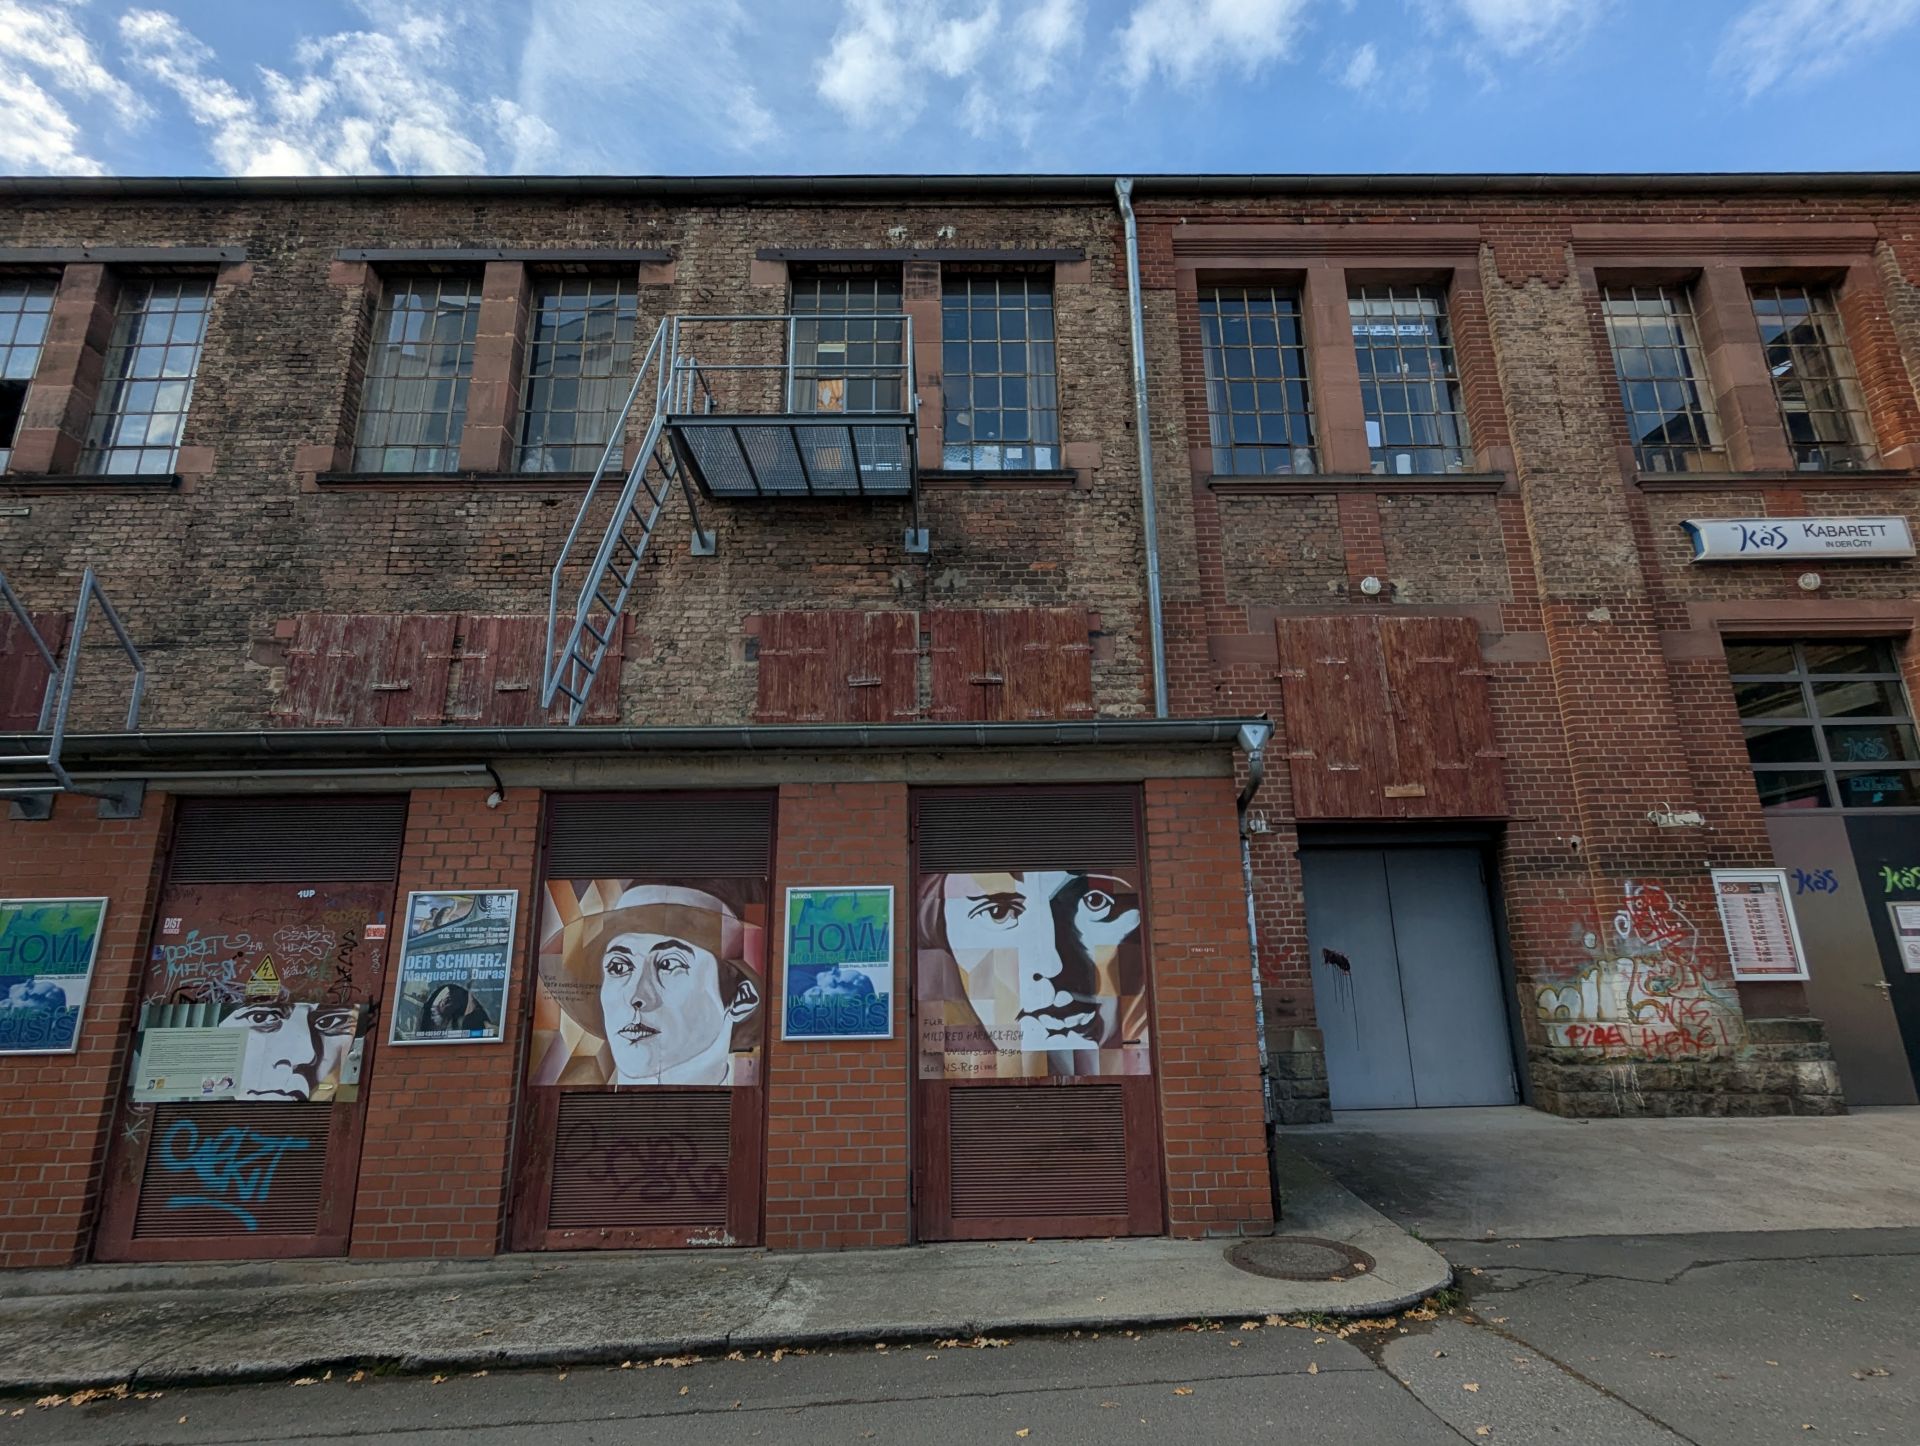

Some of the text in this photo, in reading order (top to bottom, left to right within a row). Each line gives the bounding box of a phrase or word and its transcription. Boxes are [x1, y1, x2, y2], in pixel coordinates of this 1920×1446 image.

[1802, 523, 1886, 537] KABARETT
[1836, 540, 1852, 548] DER
[1853, 539, 1872, 547] CITY
[297, 889, 316, 899] 1UP
[164, 917, 182, 930] DIST
[790, 922, 889, 954] HOW
[405, 952, 506, 970] DER SCHMERZ.
[403, 968, 505, 983] Marguerite Duras
[788, 1002, 887, 1032] CRISIS
[922, 1030, 1024, 1042] MILDRED HARNACK-FISH
[999, 1049, 1022, 1057] gegen
[944, 1062, 998, 1074] NS-Regime
